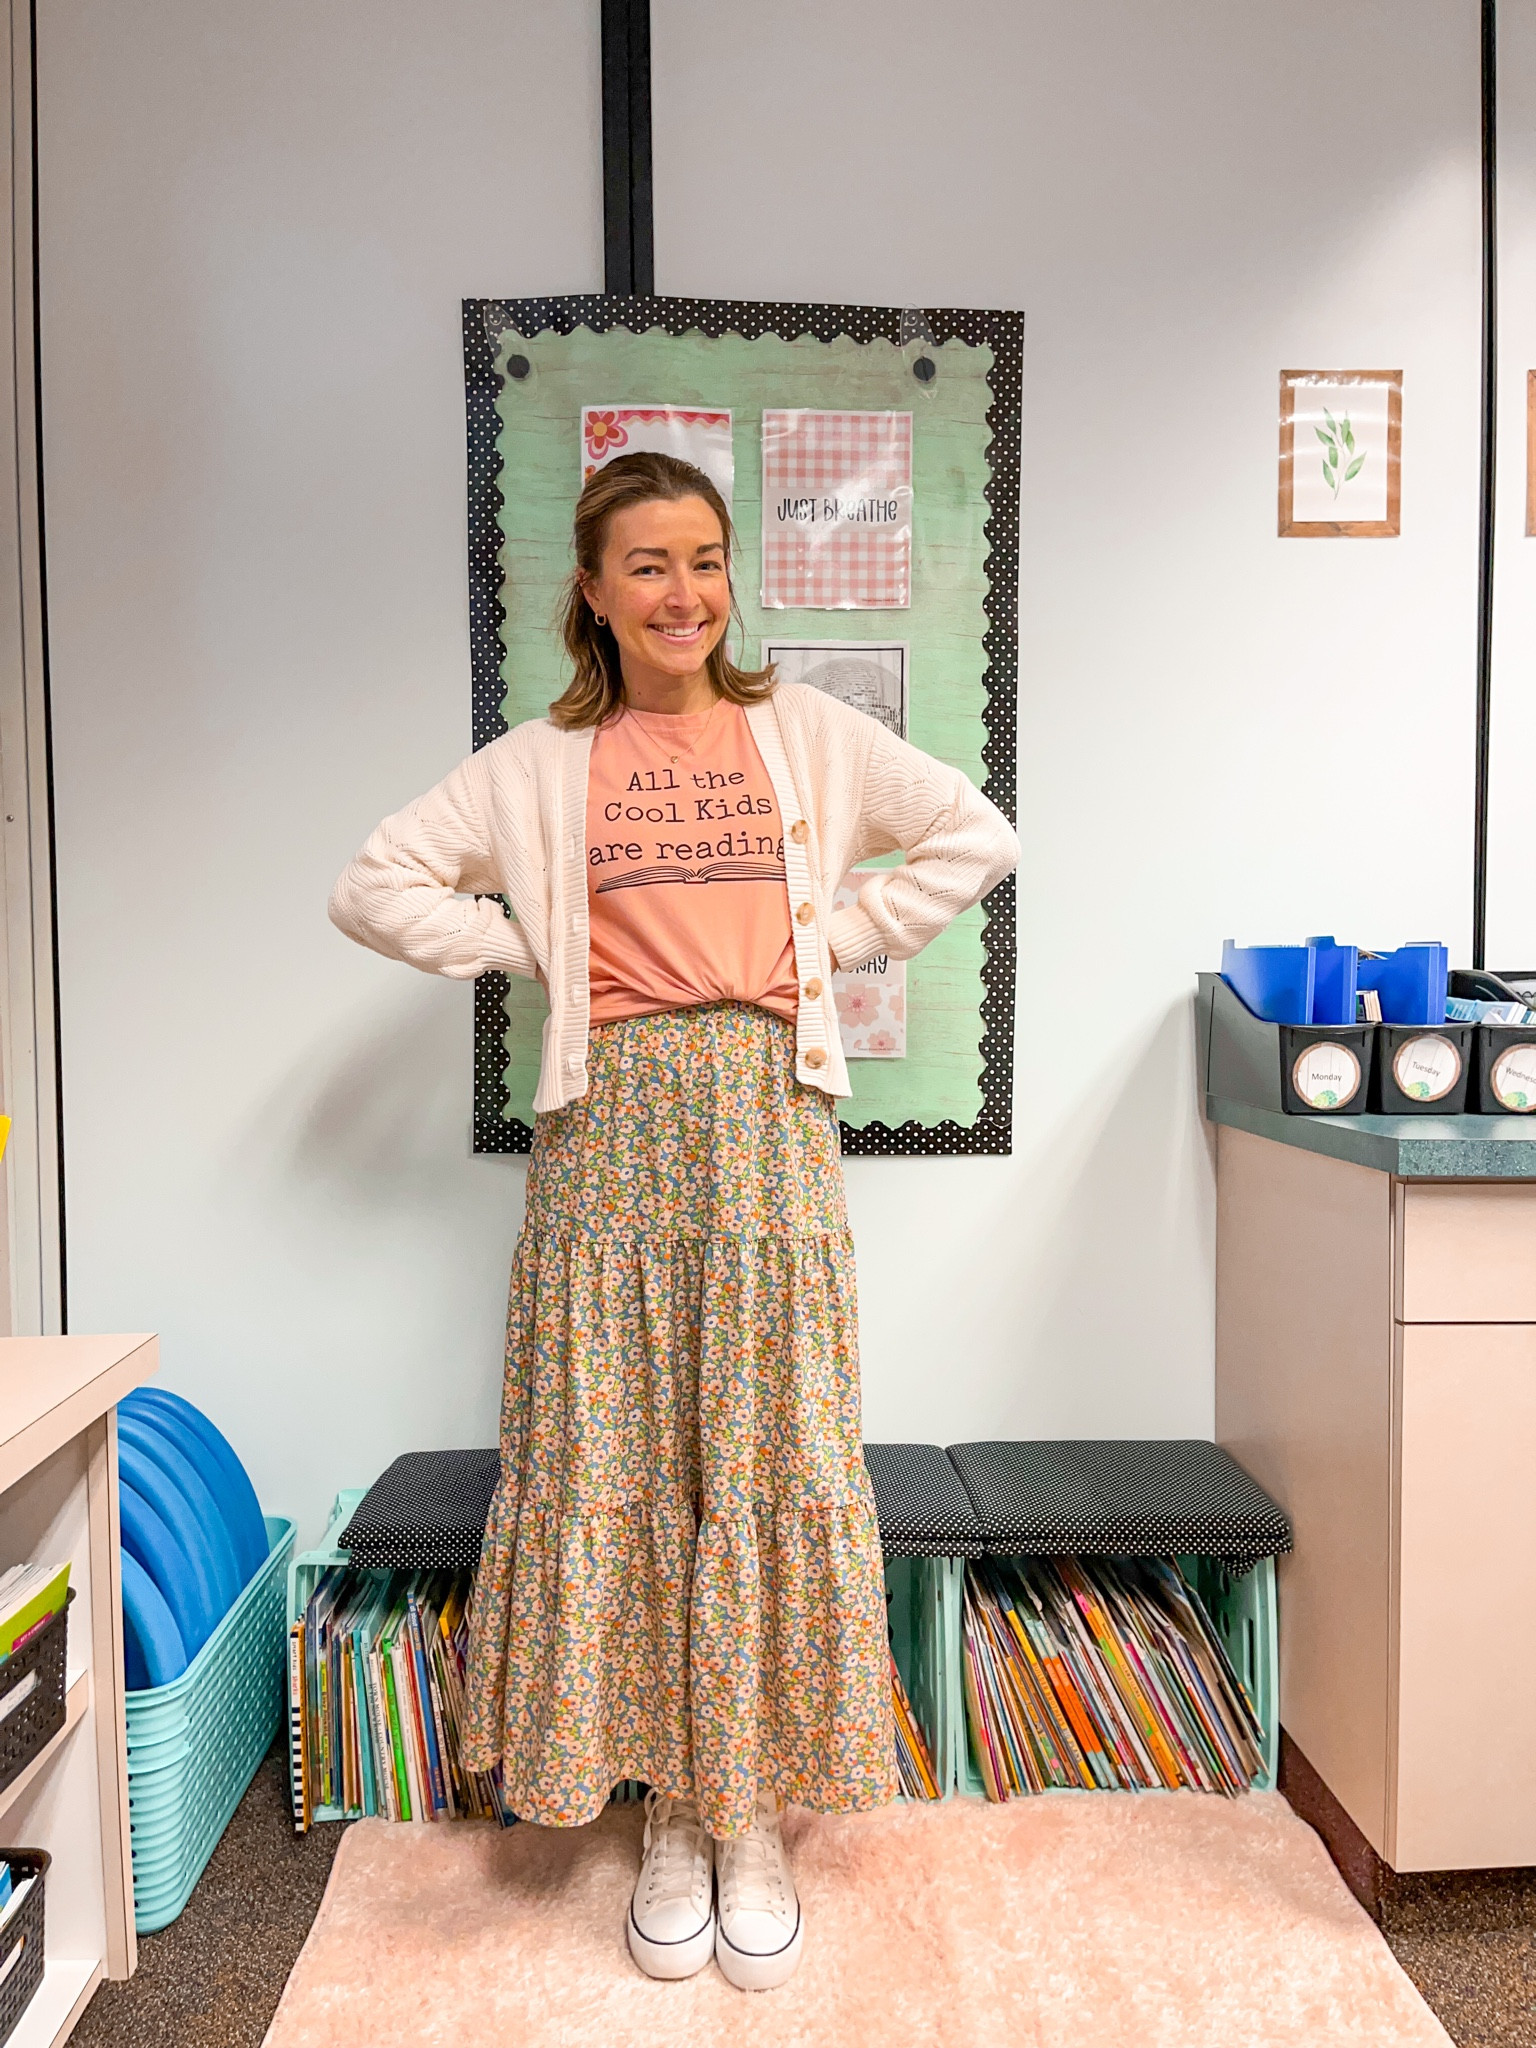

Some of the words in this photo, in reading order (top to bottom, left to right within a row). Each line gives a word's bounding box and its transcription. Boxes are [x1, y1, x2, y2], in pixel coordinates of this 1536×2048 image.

[777, 498, 817, 522] JUST
[824, 498, 898, 522] BREATHE
[626, 769, 680, 792] All
[690, 771, 745, 790] the
[604, 802, 685, 822] Cool
[694, 794, 772, 821] Kids
[589, 842, 643, 866] are
[656, 831, 786, 862] reading
[1311, 1072, 1342, 1082] Monday
[1412, 1061, 1441, 1077] Tuesday
